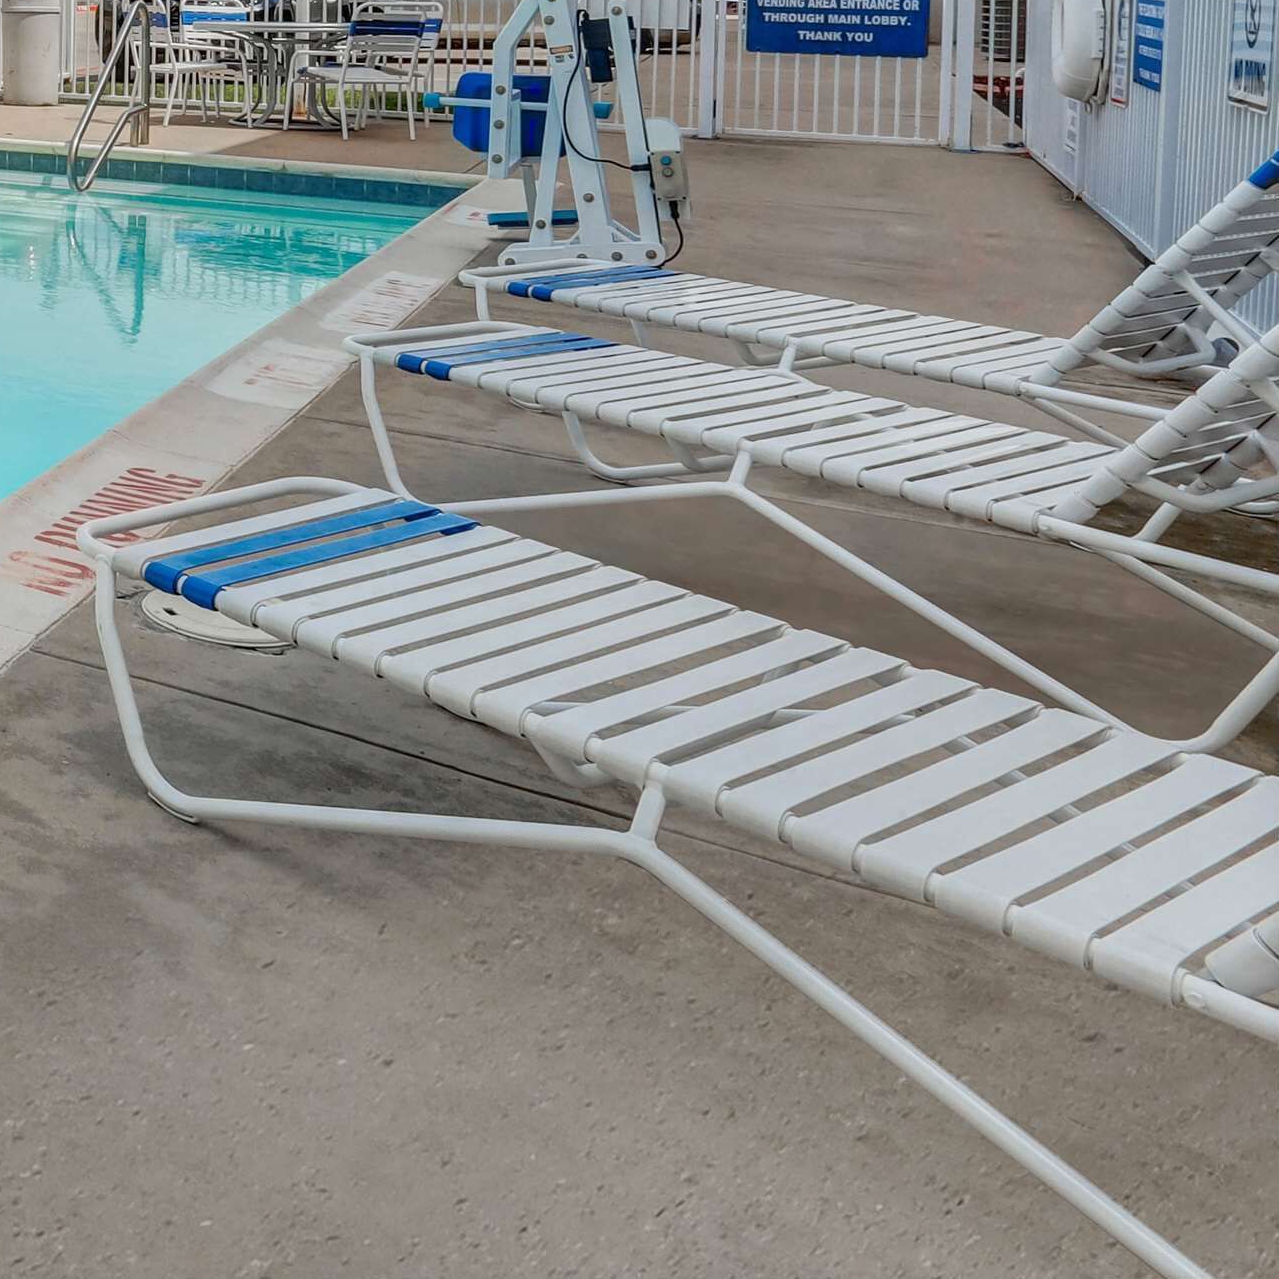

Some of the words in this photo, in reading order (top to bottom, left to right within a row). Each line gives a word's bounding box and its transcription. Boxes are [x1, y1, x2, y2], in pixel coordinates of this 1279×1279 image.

[903, 0, 920, 11] OR
[763, 12, 824, 23] THROUGH
[828, 13, 859, 24] MAIN
[864, 15, 911, 26] LOBBY.
[797, 30, 842, 41] THANK
[846, 32, 873, 42] YOU
